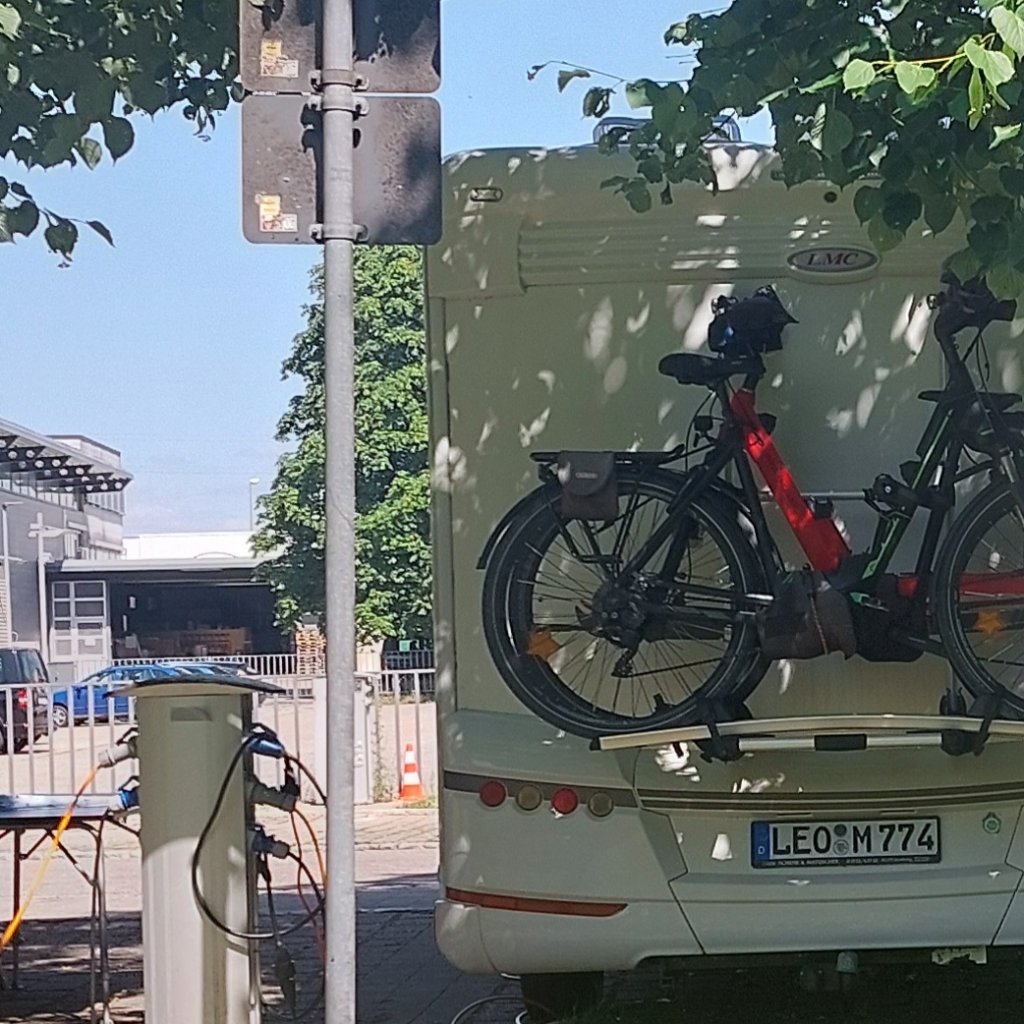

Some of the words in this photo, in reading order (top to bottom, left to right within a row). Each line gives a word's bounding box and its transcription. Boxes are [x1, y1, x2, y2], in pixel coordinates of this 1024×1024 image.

[807, 252, 859, 266] LMC
[772, 826, 832, 855] LEO
[852, 825, 872, 853] M
[878, 823, 935, 852] 774
[757, 845, 766, 855] D
